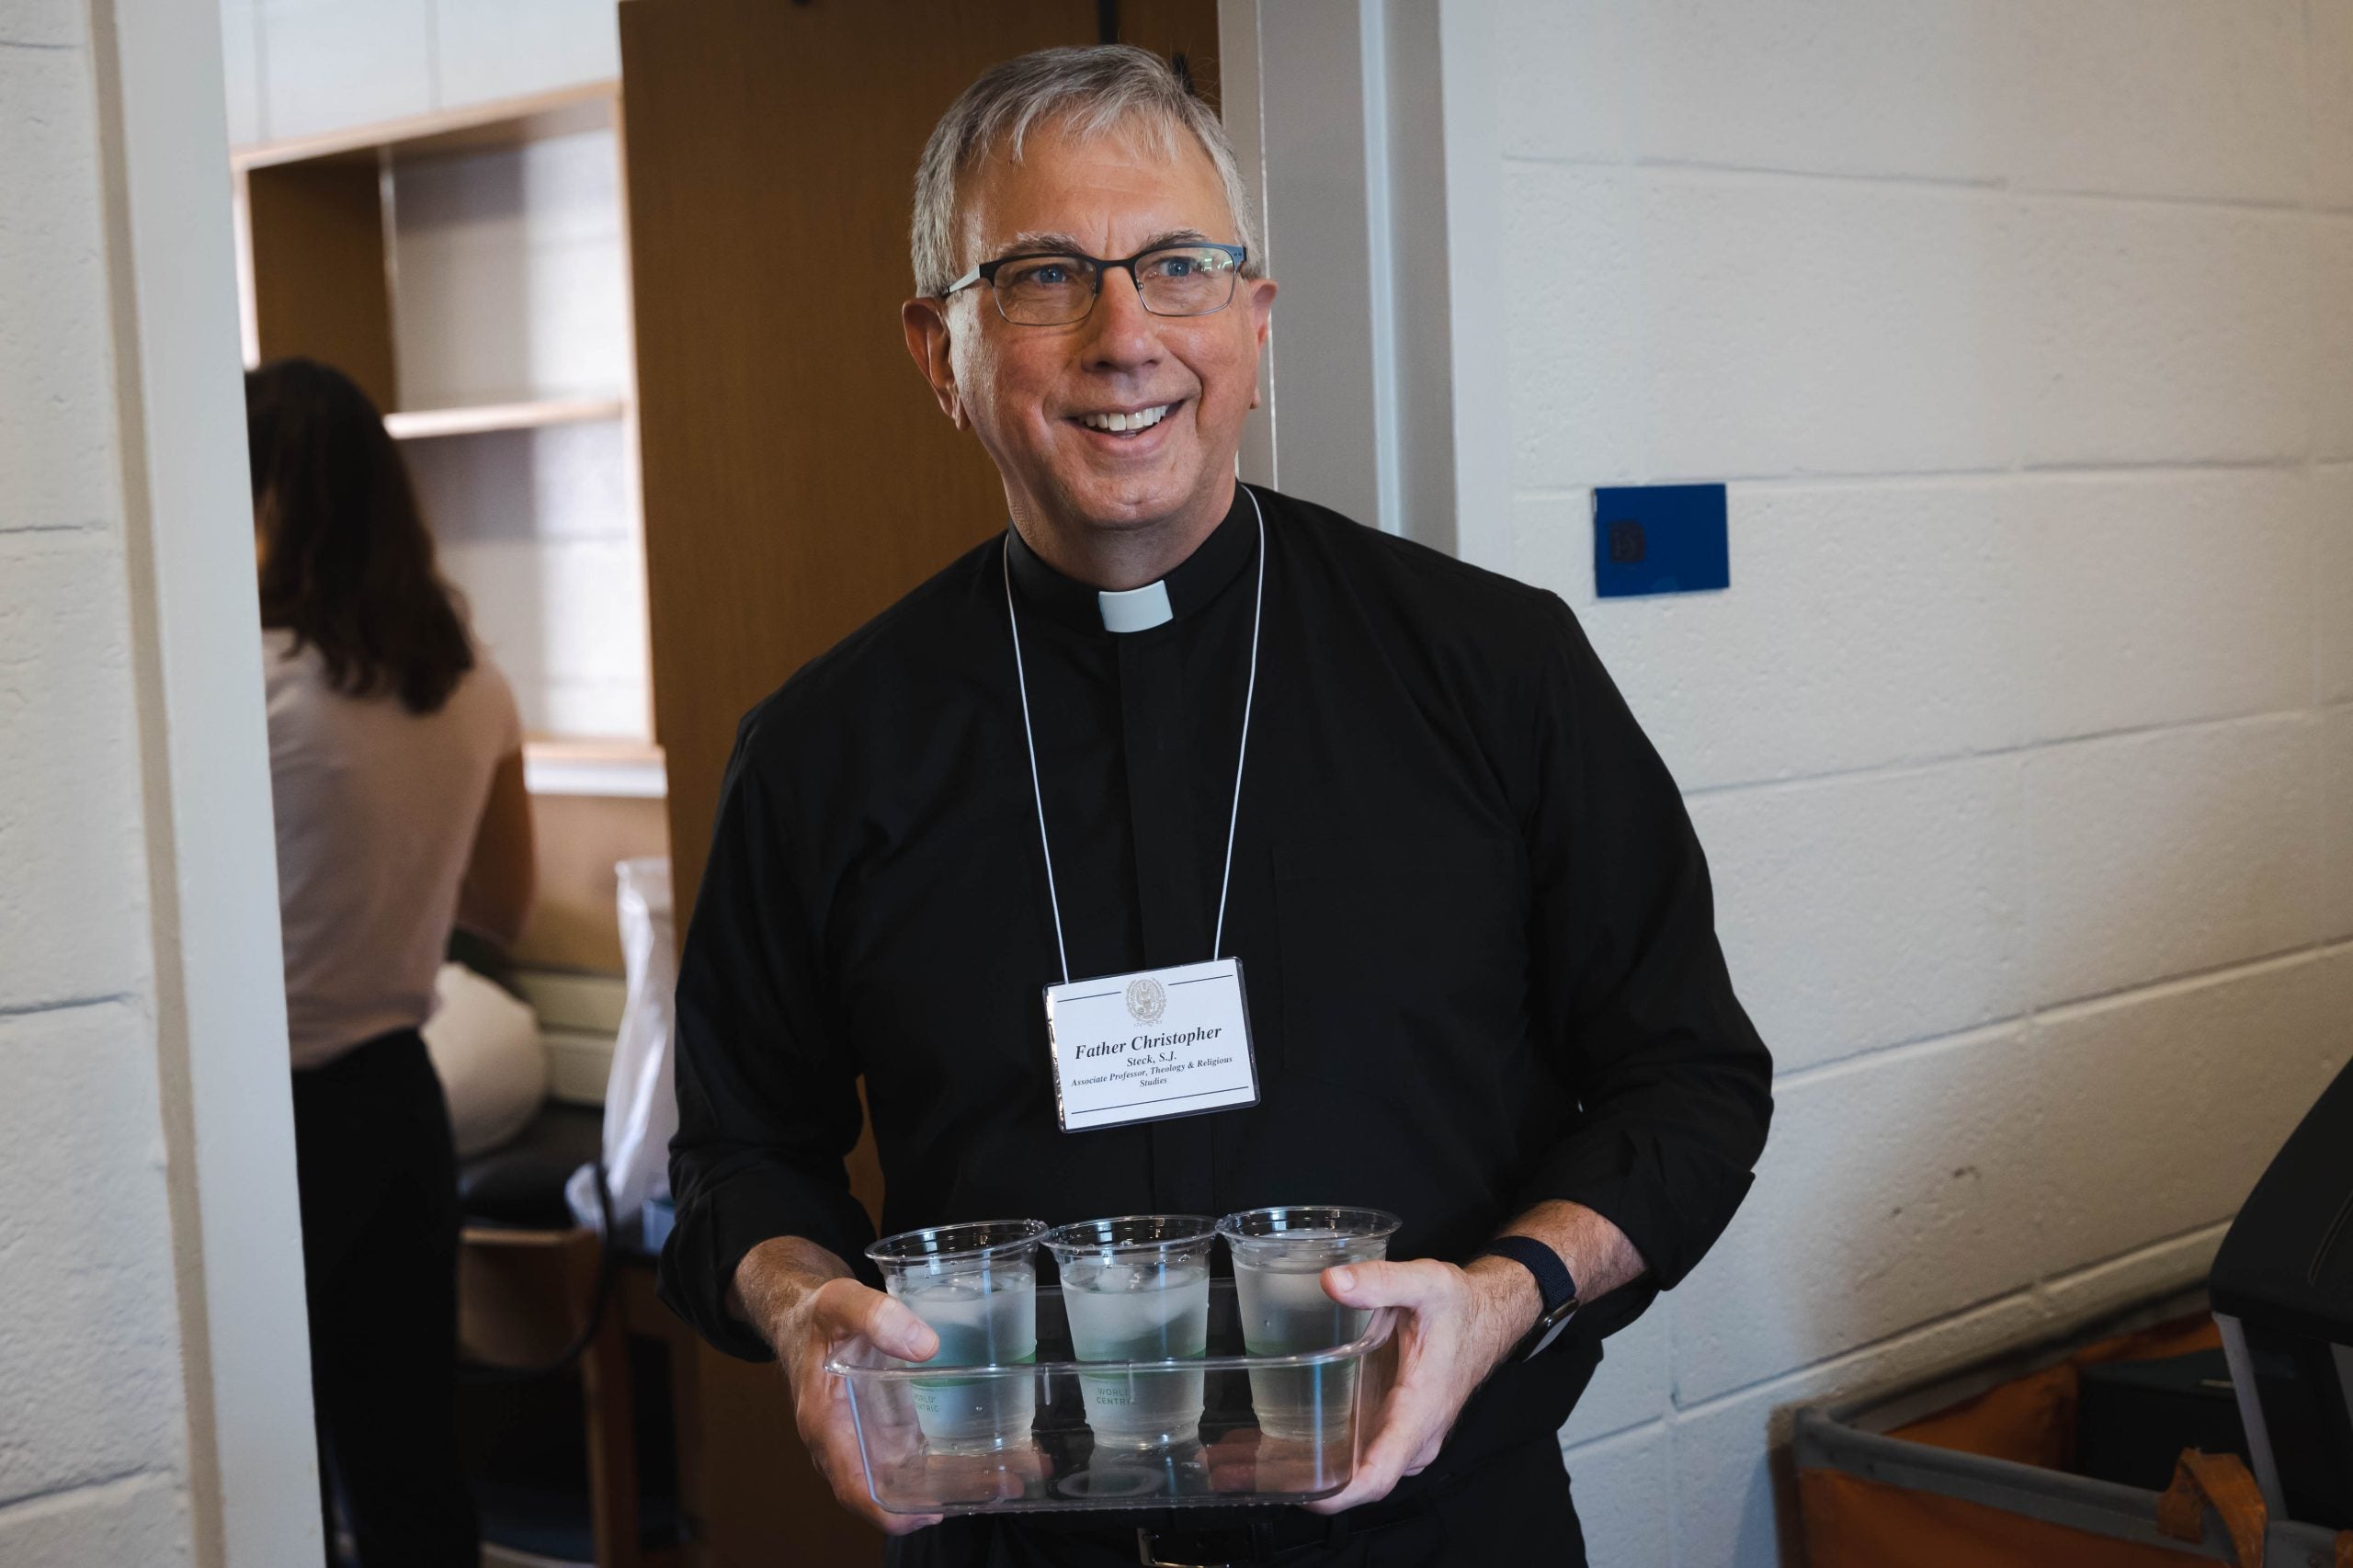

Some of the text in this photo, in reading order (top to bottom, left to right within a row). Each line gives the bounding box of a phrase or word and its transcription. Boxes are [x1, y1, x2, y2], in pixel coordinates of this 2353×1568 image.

[1075, 1027, 1222, 1060] Father Christopher
[1071, 1055, 1233, 1087] Associate Professor, Theology & Religious
[1126, 1051, 1177, 1067] Steck, S.J.
[1140, 1076, 1167, 1087] Studies
